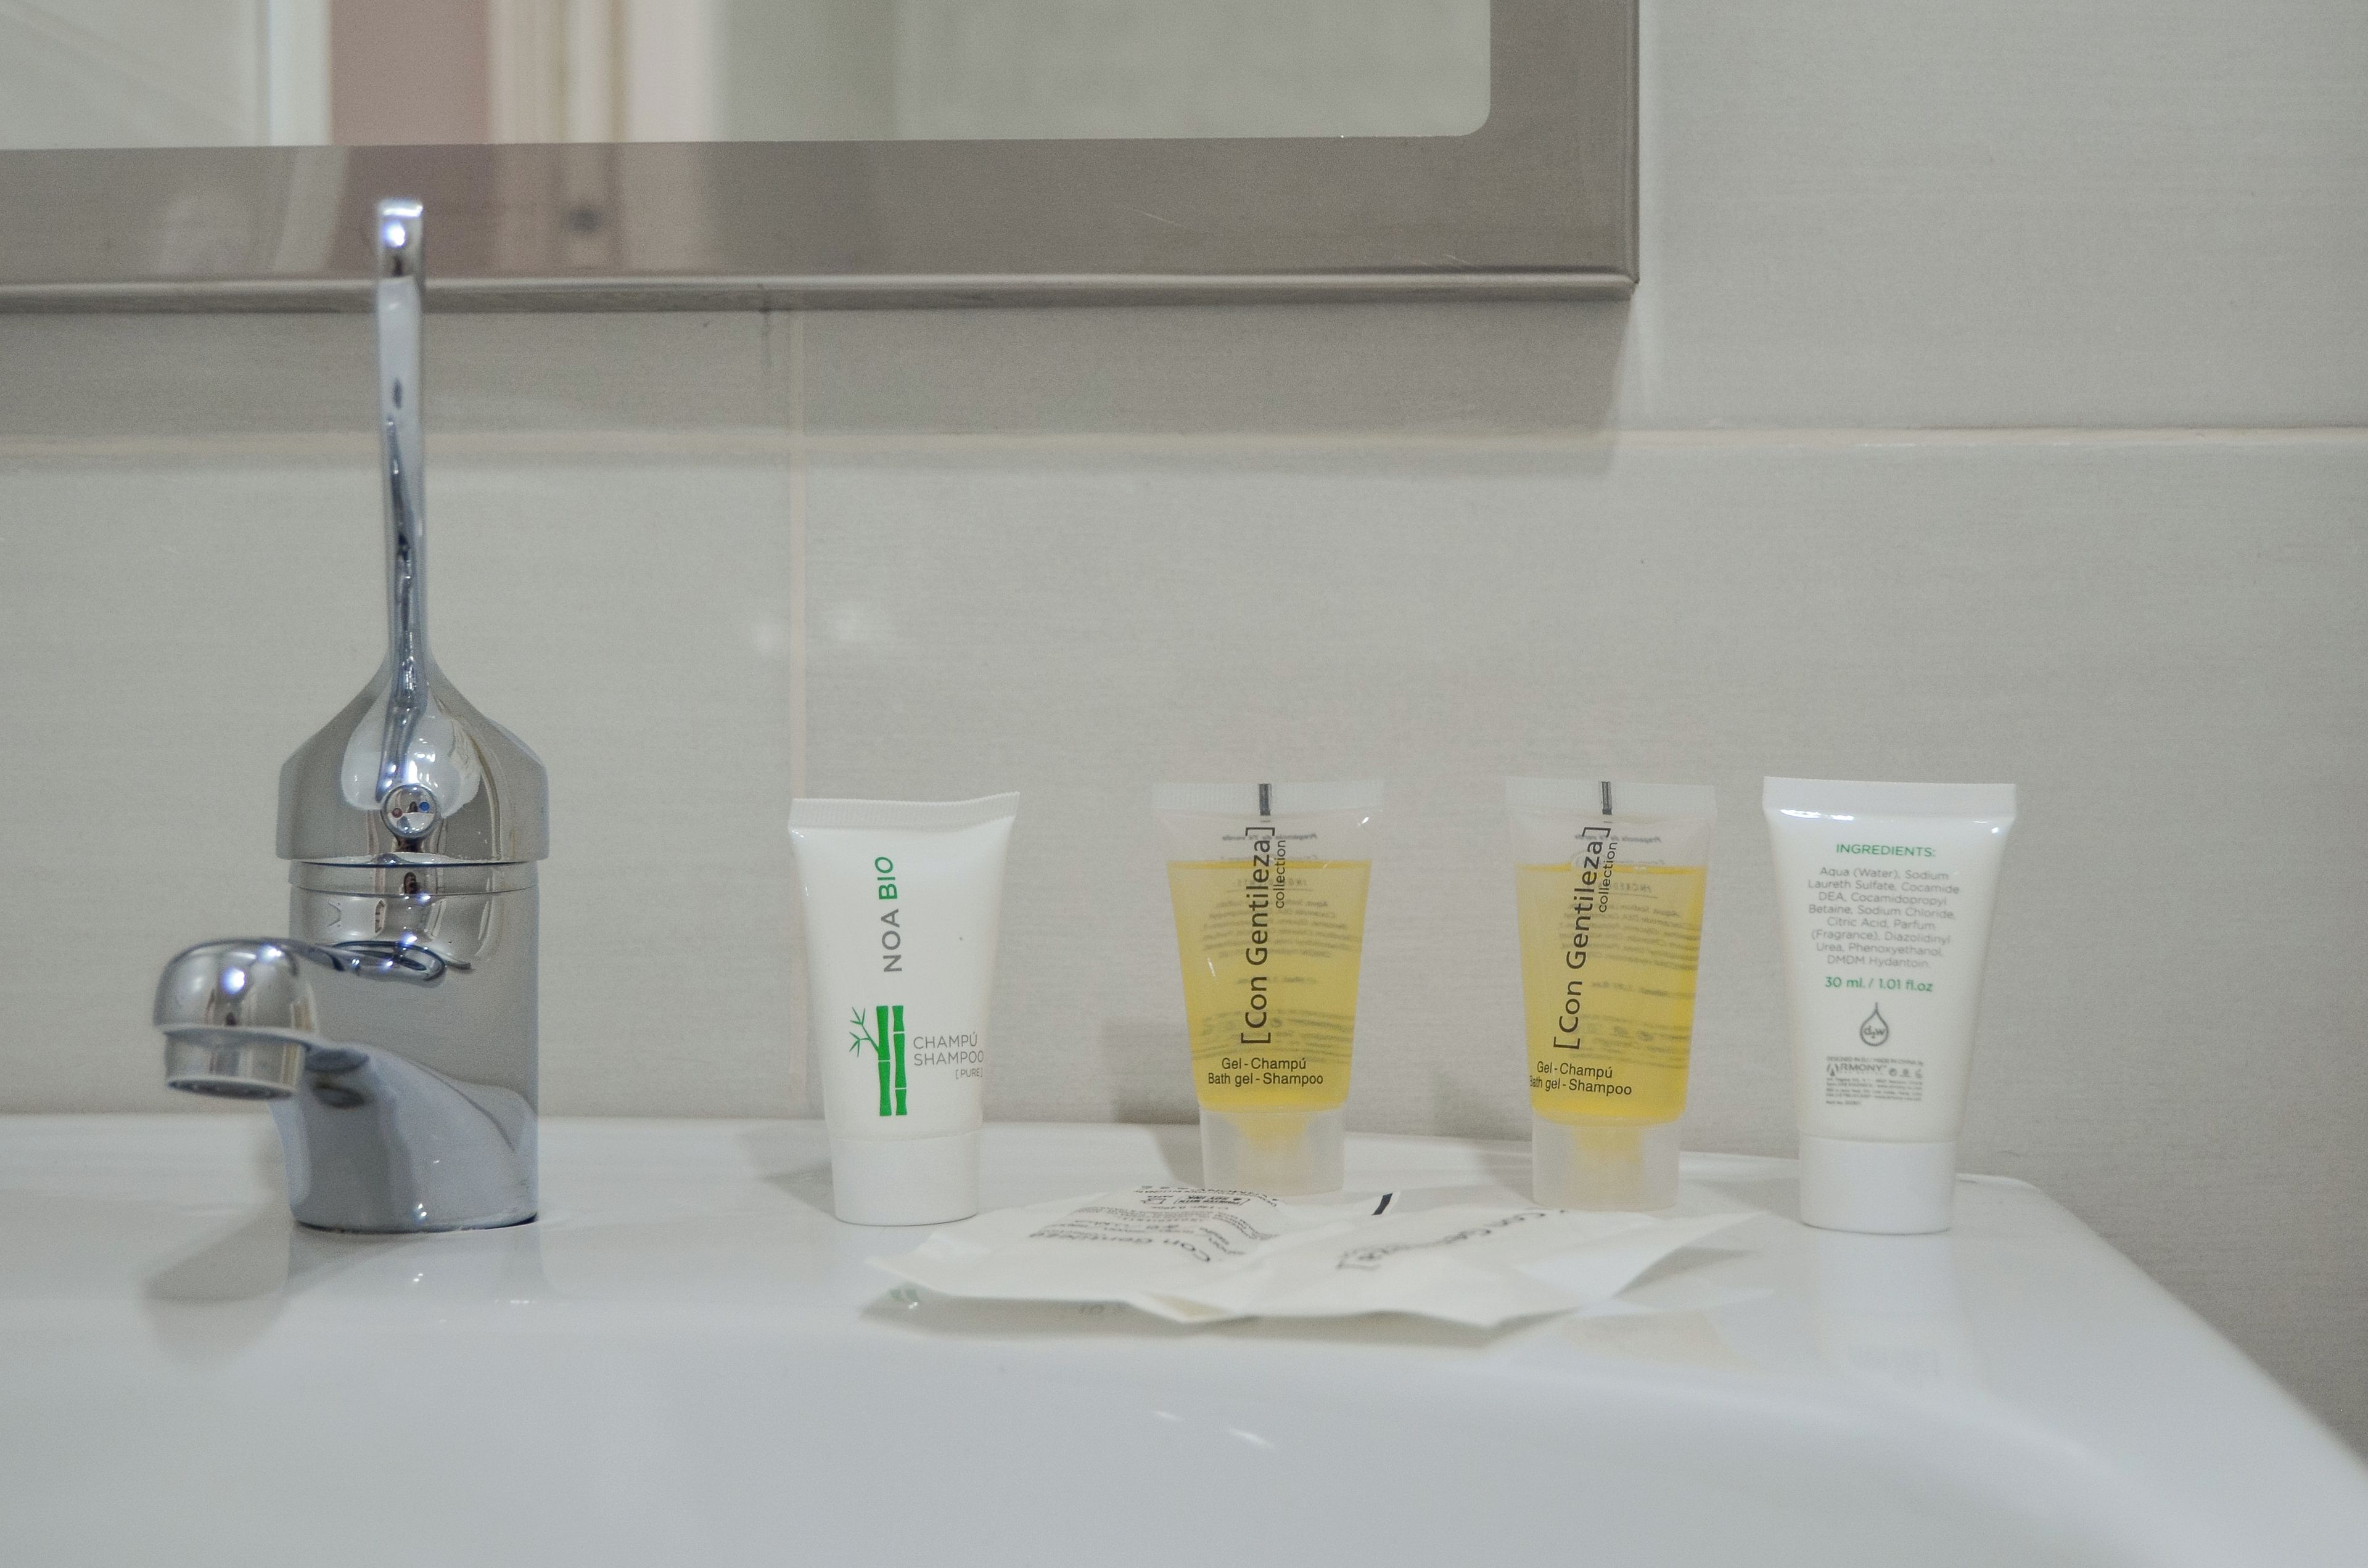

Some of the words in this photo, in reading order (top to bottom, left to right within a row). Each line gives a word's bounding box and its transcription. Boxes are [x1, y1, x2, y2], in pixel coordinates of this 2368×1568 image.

[1836, 844, 1935, 857] INGREDIENTS:
[874, 856, 898, 900] BIO
[1273, 840, 1286, 908] collection
[1599, 842, 1618, 913] collection
[1820, 867, 1849, 877] Aqua
[1906, 870, 1949, 880] Sodium
[1808, 879, 1850, 889] Laureth
[1901, 882, 1960, 893] Cocamide
[1246, 827, 1275, 965] Gentileza]
[1566, 827, 1611, 969] Gentileza]
[1819, 892, 1846, 901] DEA,
[1851, 892, 1947, 906] Cocamidopropyl
[1809, 905, 1852, 914] Betaine,
[1857, 905, 1901, 915] Sodium
[1827, 917, 1857, 927] Citric
[1861, 918, 1889, 928] Acid,
[1894, 919, 1934, 929] Parfum
[881, 909, 902, 972] NOA
[1885, 932, 1950, 945] Diazolidinyl
[1817, 943, 1844, 951] Urea,
[1827, 955, 1865, 964] DMDM
[1826, 977, 1841, 987] 30
[1879, 979, 1901, 988] 1.01
[1241, 977, 1271, 1044] [Con
[1553, 981, 1583, 1049] [Con
[913, 1032, 977, 1049] CHAMPÚ
[915, 1051, 984, 1066] SHAMPOO
[1222, 1057, 1241, 1070] Gel
[1251, 1057, 1306, 1073] Champú
[1537, 1061, 1552, 1073] Gel
[1560, 1063, 1613, 1078] Champú
[1208, 1073, 1231, 1085] Bath
[1235, 1073, 1252, 1087] gel
[1264, 1073, 1323, 1087] Shampoo
[1545, 1077, 1560, 1091] gel
[1569, 1079, 1632, 1096] Shampoo
